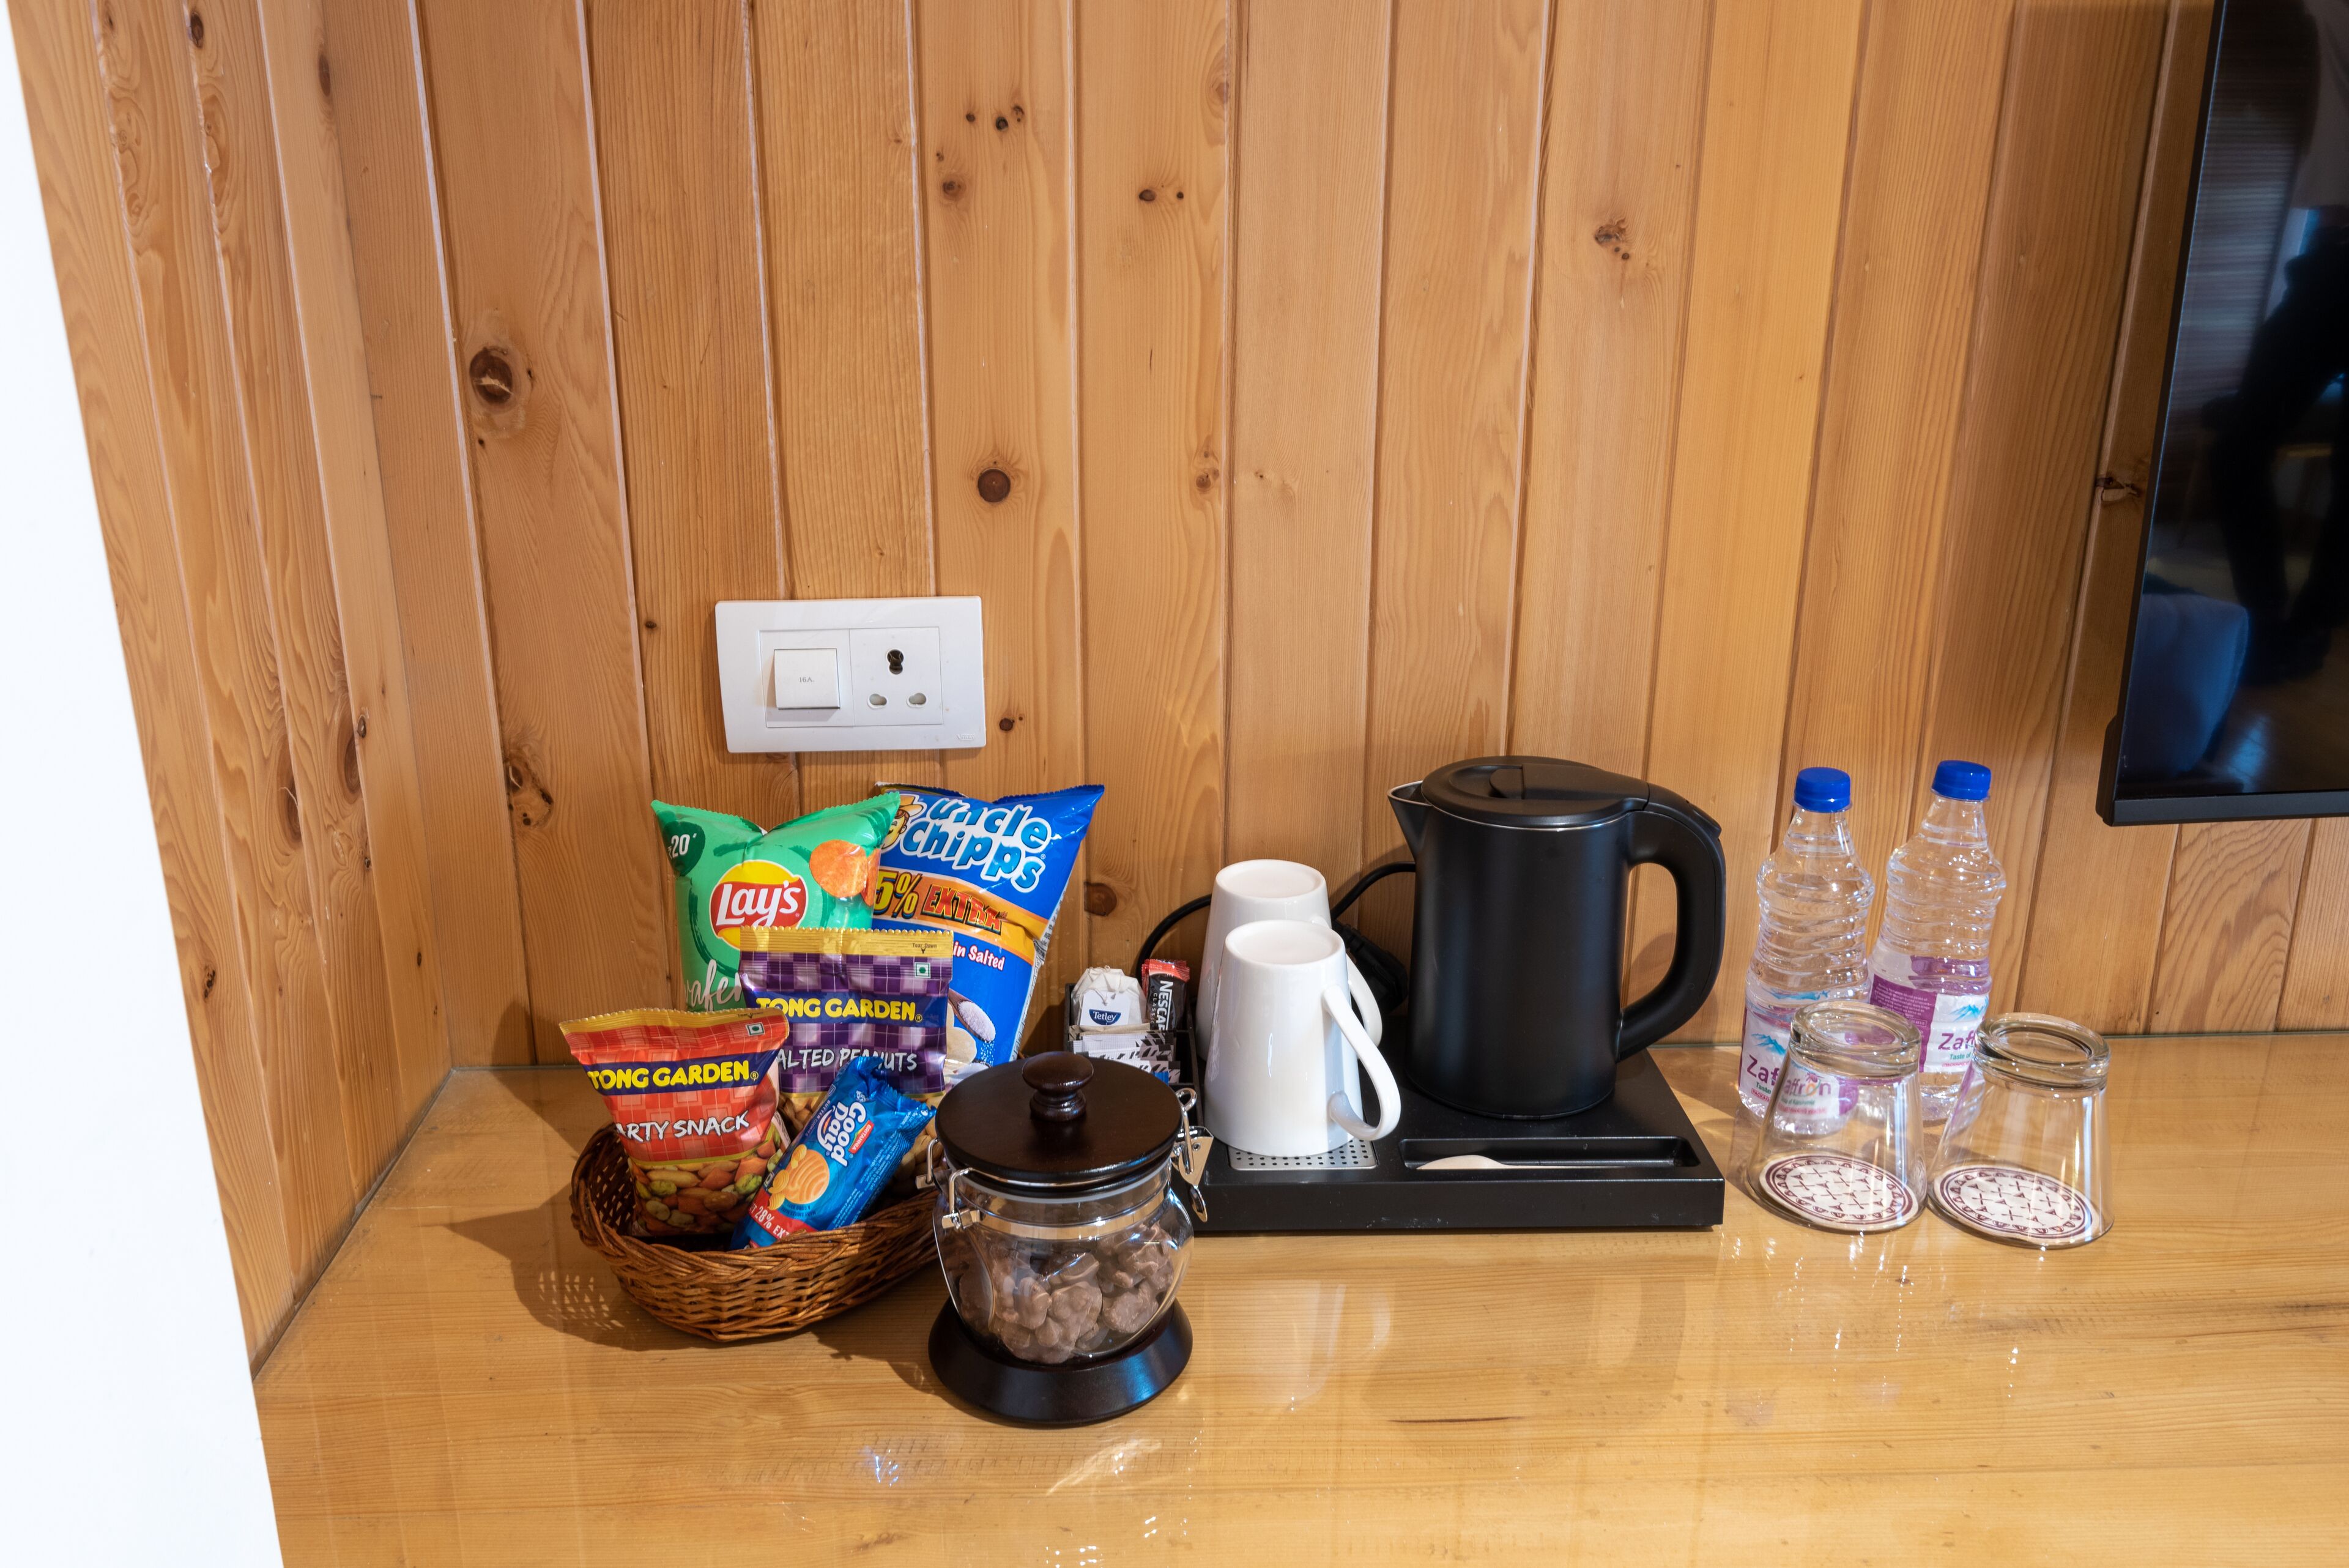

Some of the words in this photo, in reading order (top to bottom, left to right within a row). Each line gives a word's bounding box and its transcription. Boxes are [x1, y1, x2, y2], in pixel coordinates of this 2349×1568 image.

[929, 799, 1048, 849] Uncle
[902, 821, 1043, 890] Chipps
[716, 880, 801, 927] Lay's
[921, 885, 1001, 935] EXTRA
[968, 945, 1005, 972] Salted
[756, 998, 820, 1017] TONG
[825, 998, 916, 1022] GARDEN
[1093, 1011, 1118, 1023] Tetley
[588, 1068, 648, 1090] TONG
[653, 1060, 749, 1087] GARDEN
[674, 1110, 749, 1139] SNACK
[817, 1101, 848, 1152] Day
[831, 1102, 866, 1167] Good
[852, 1124, 872, 1151] BRITANNIA
[755, 1206, 775, 1229] 28%
